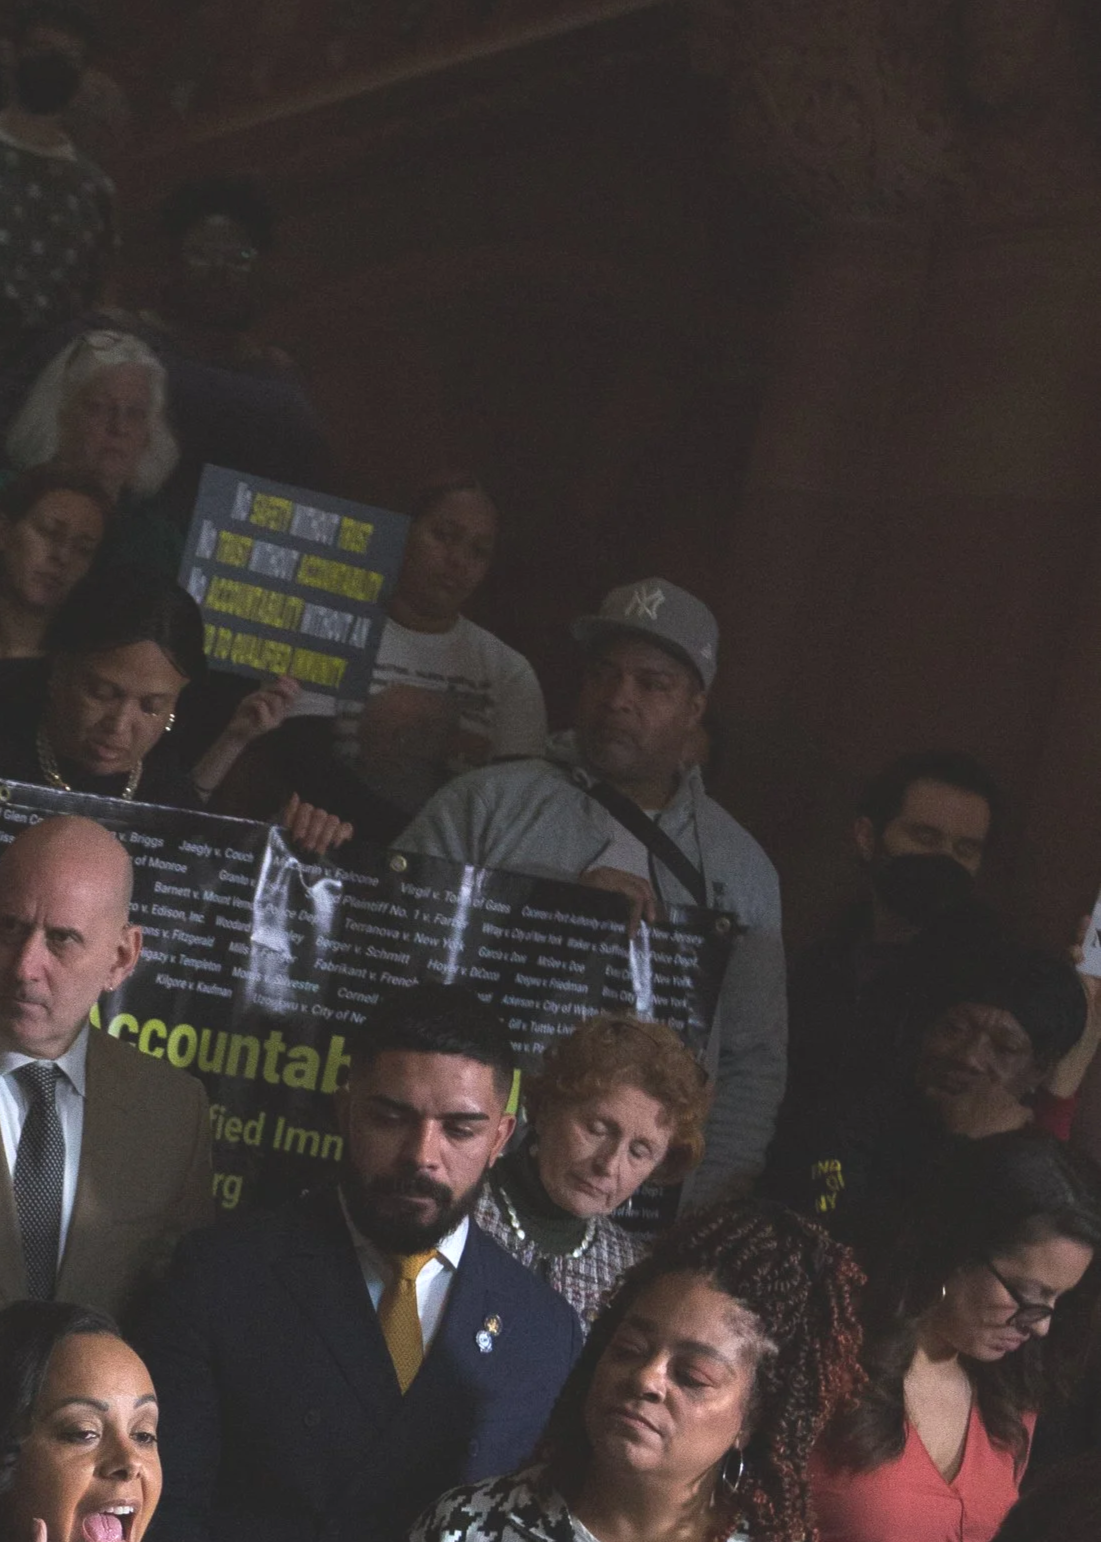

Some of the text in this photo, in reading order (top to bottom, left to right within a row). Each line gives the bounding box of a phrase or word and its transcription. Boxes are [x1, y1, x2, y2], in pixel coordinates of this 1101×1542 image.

[3, 808, 27, 824] Glen
[29, 813, 44, 826] Co
[129, 833, 165, 850] Briggs
[224, 847, 255, 863] Couch
[149, 859, 188, 874] Monroe
[334, 867, 379, 887] Falcone
[154, 881, 192, 899] Barnett
[400, 881, 431, 899] Virgil
[342, 895, 387, 915] Plaintiff
[389, 904, 409, 919] No.
[345, 917, 400, 940] Terranova
[315, 935, 353, 953] Berger
[365, 944, 411, 965] Schmitt
[314, 958, 367, 978] Fabrikant
[311, 1003, 333, 1021] City
[334, 1008, 350, 1022] of
[209, 1104, 266, 1147] fied
[212, 1172, 243, 1209] rg
